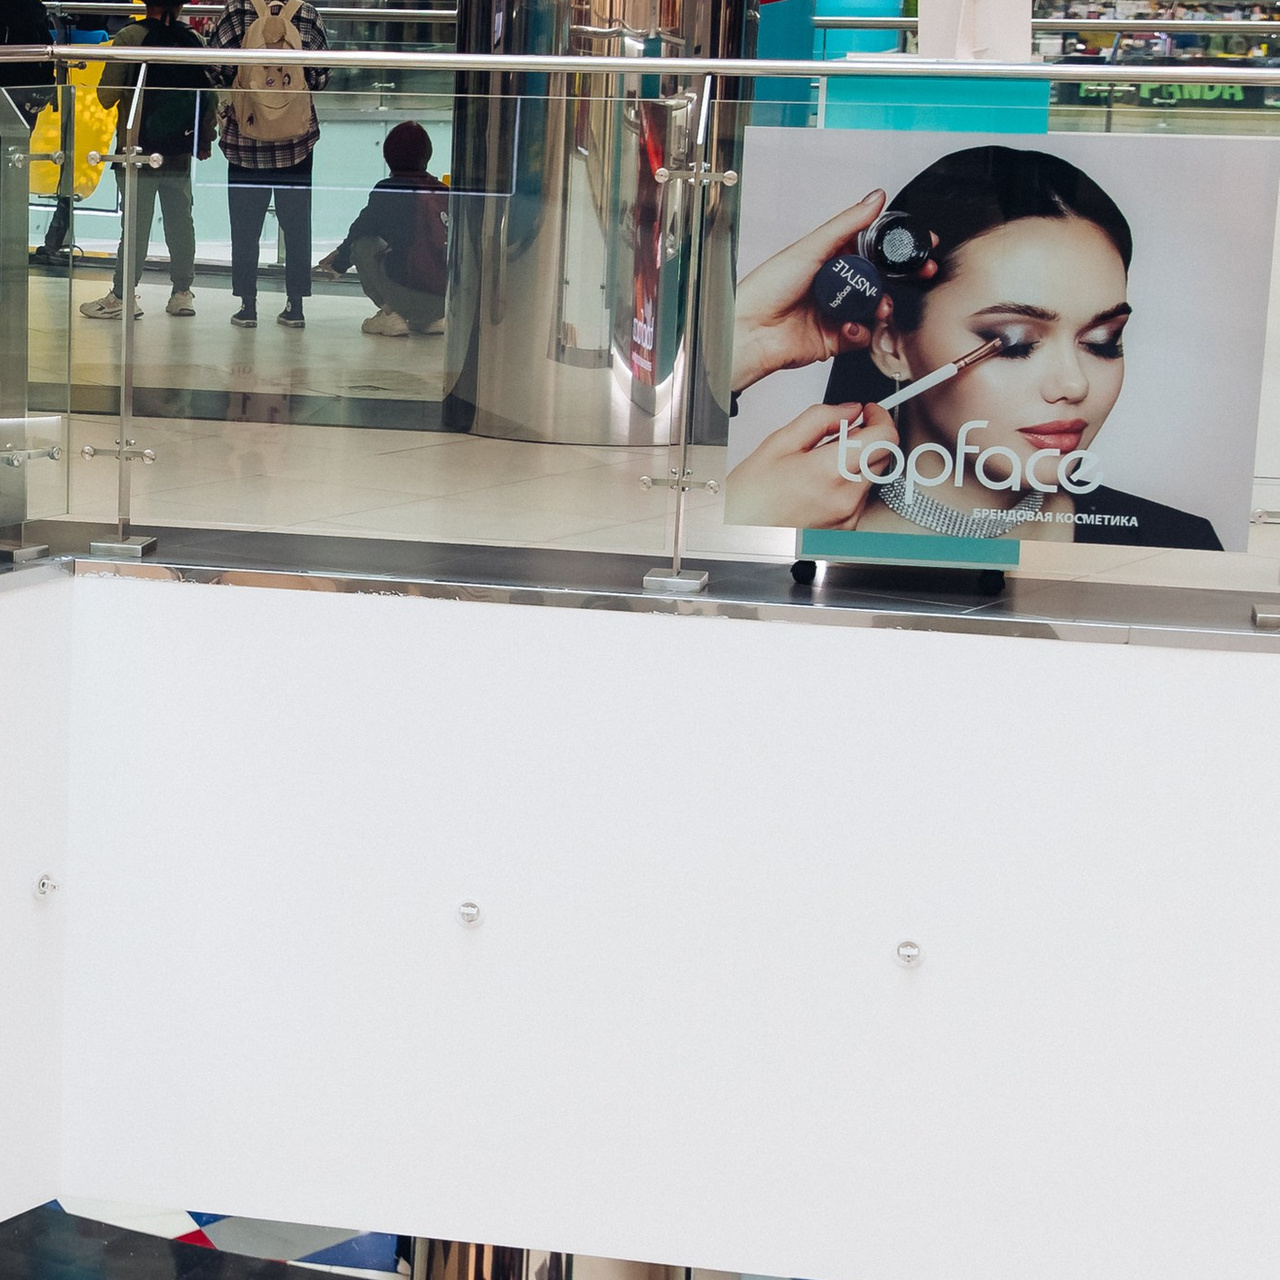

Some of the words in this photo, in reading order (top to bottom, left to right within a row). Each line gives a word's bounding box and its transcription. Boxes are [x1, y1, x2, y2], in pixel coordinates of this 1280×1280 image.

[837, 419, 1104, 506] topface
[973, 508, 1053, 523] БРЕНДОВАЯ
[1056, 511, 1139, 527] КОСМЕТИКА
